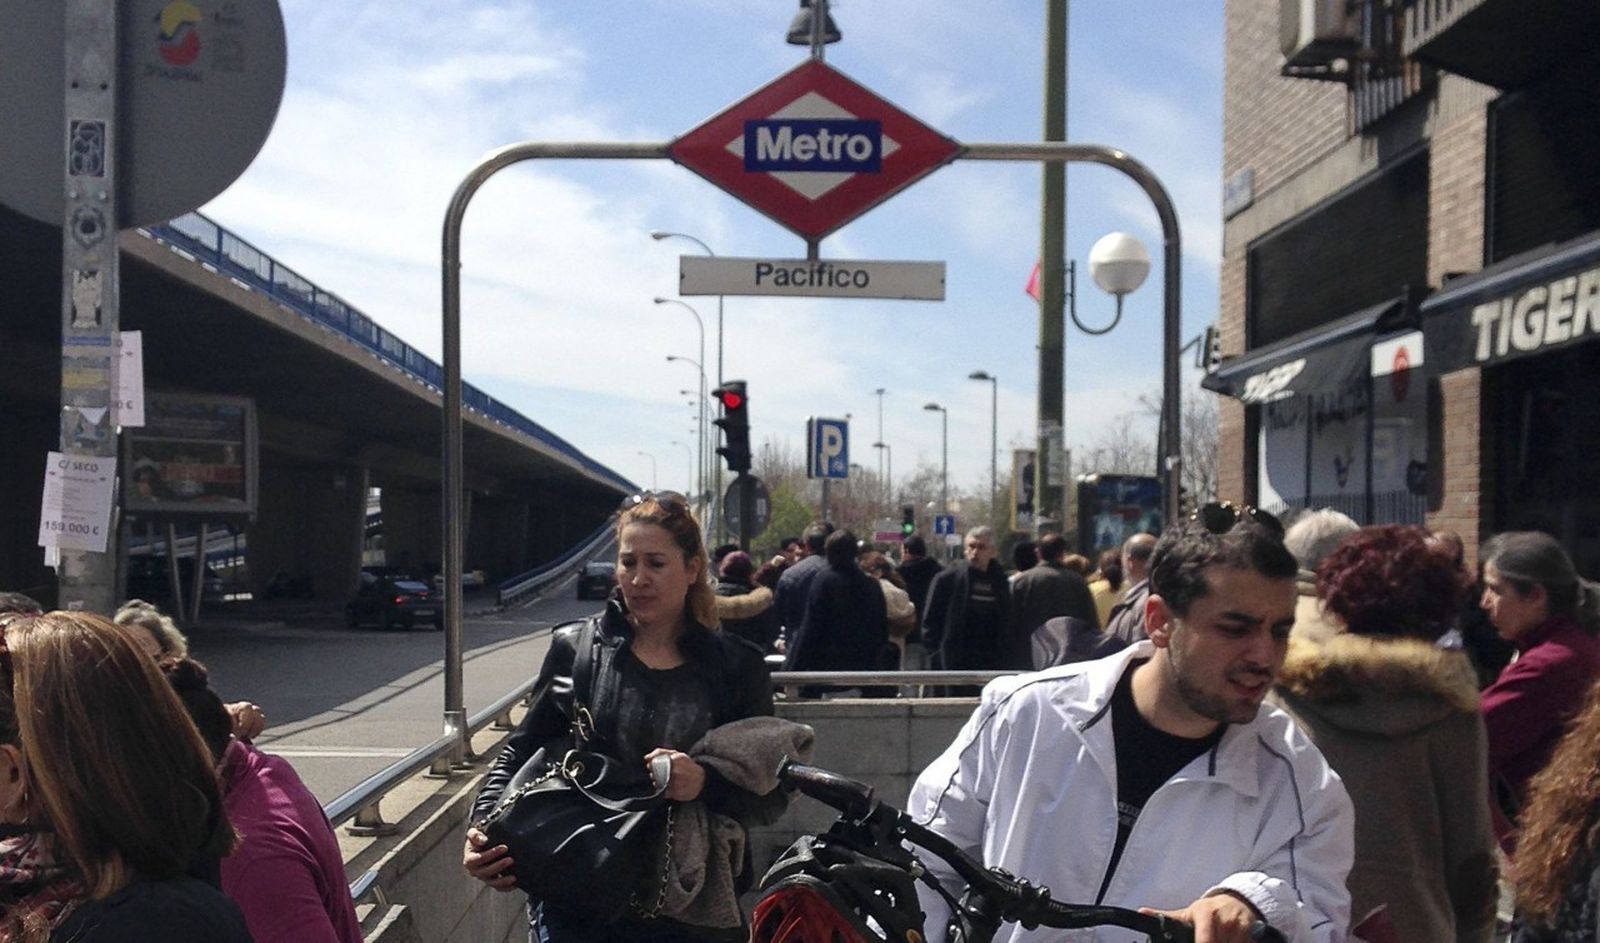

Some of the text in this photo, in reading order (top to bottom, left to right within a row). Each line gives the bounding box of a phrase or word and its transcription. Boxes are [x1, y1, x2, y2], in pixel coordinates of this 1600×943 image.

[756, 126, 873, 161] Metro
[1471, 267, 1600, 361] TIGER
[820, 424, 843, 475] P
